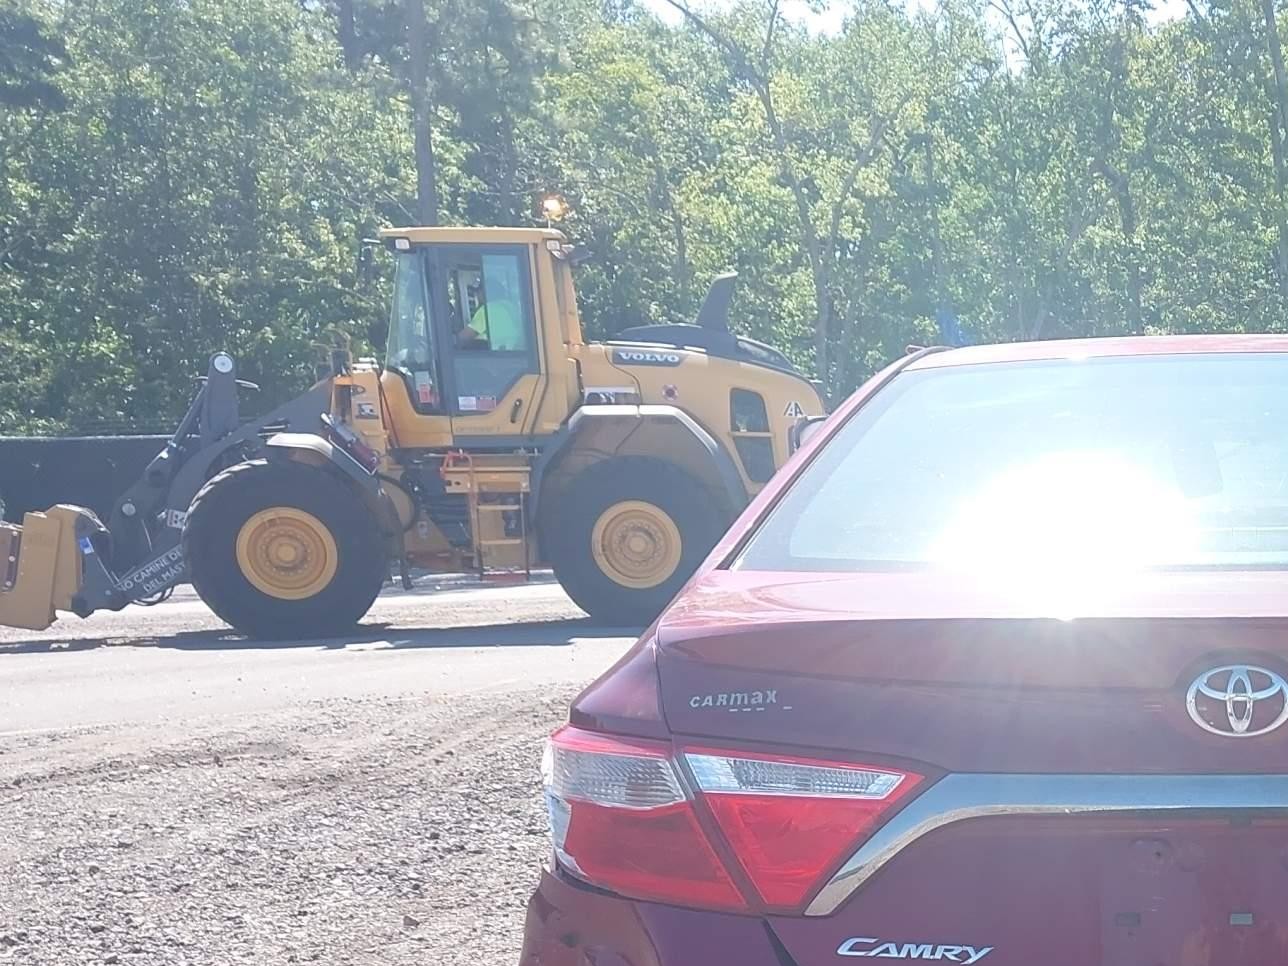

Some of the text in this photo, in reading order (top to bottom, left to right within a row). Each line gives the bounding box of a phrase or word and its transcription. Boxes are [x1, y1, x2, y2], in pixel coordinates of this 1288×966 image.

[619, 351, 680, 362] VOLVO
[117, 580, 134, 592] NO
[133, 557, 169, 583] CAMINE
[837, 937, 995, 965] CAMRY
